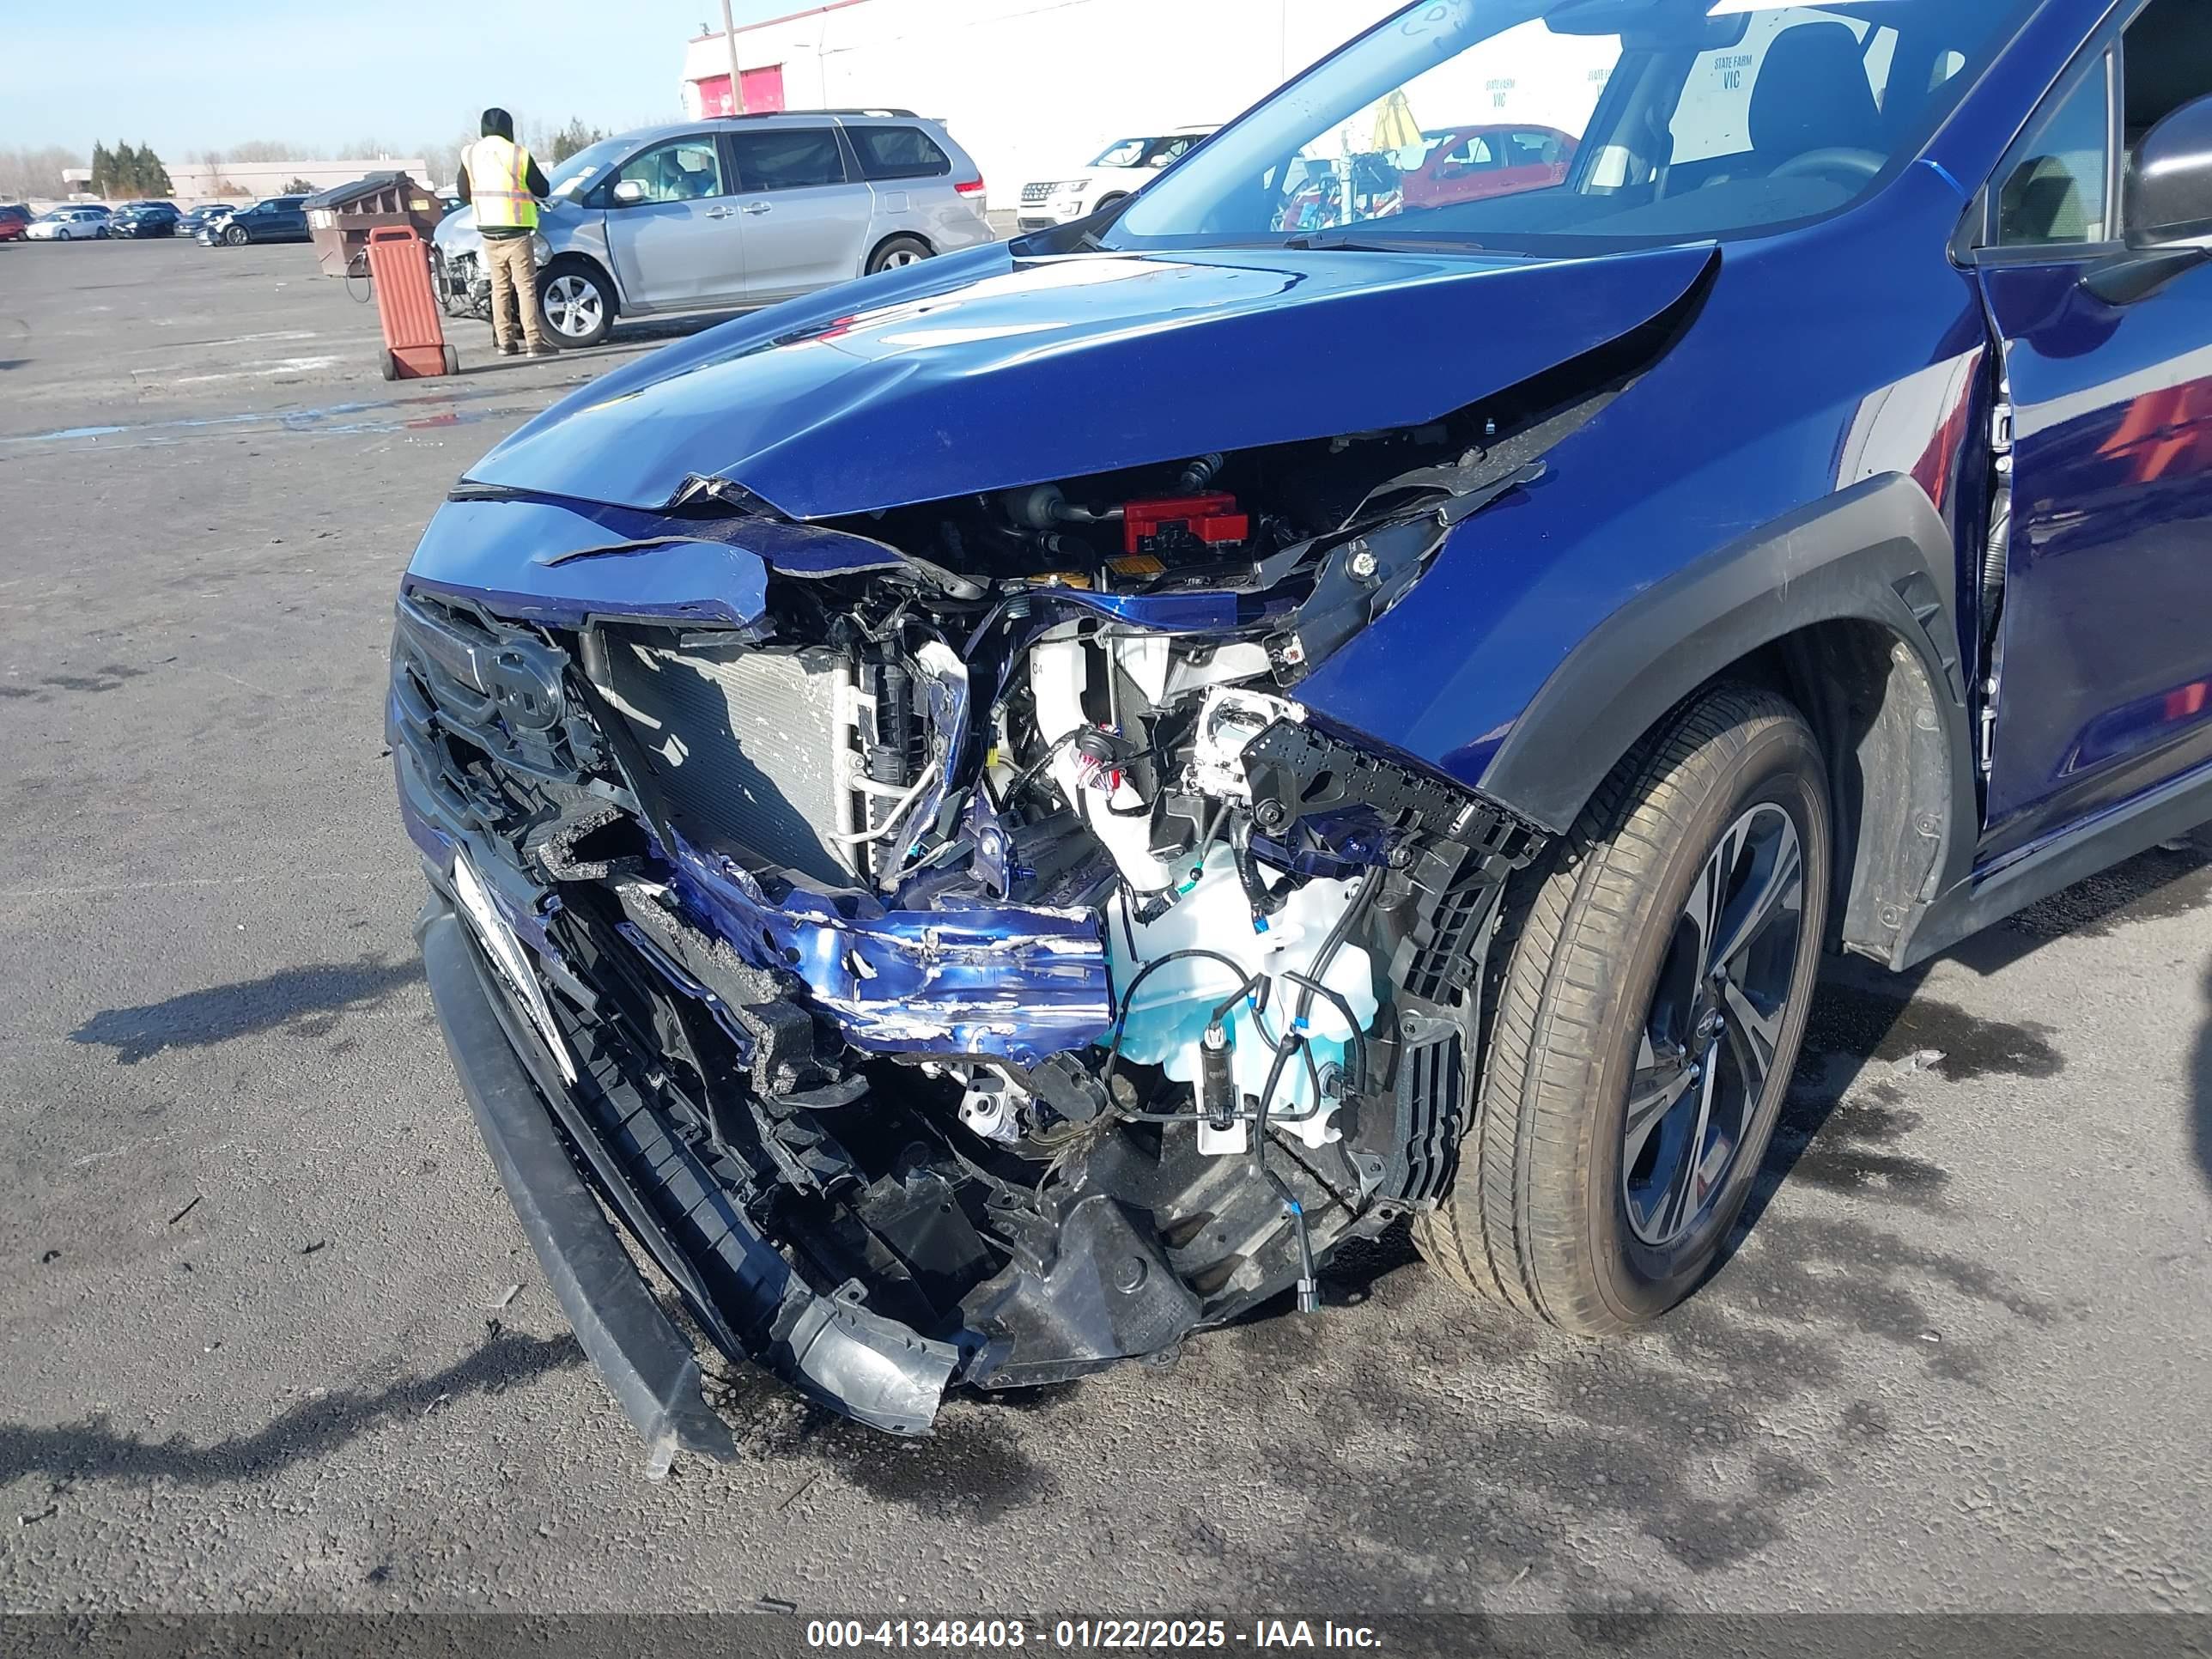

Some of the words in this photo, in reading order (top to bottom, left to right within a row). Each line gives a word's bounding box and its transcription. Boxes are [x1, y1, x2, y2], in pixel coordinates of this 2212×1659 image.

[1715, 57, 1732, 70] STATE
[1734, 55, 1752, 68] FARM
[1724, 70, 1741, 89] VIC
[1493, 92, 1506, 107] VIC
